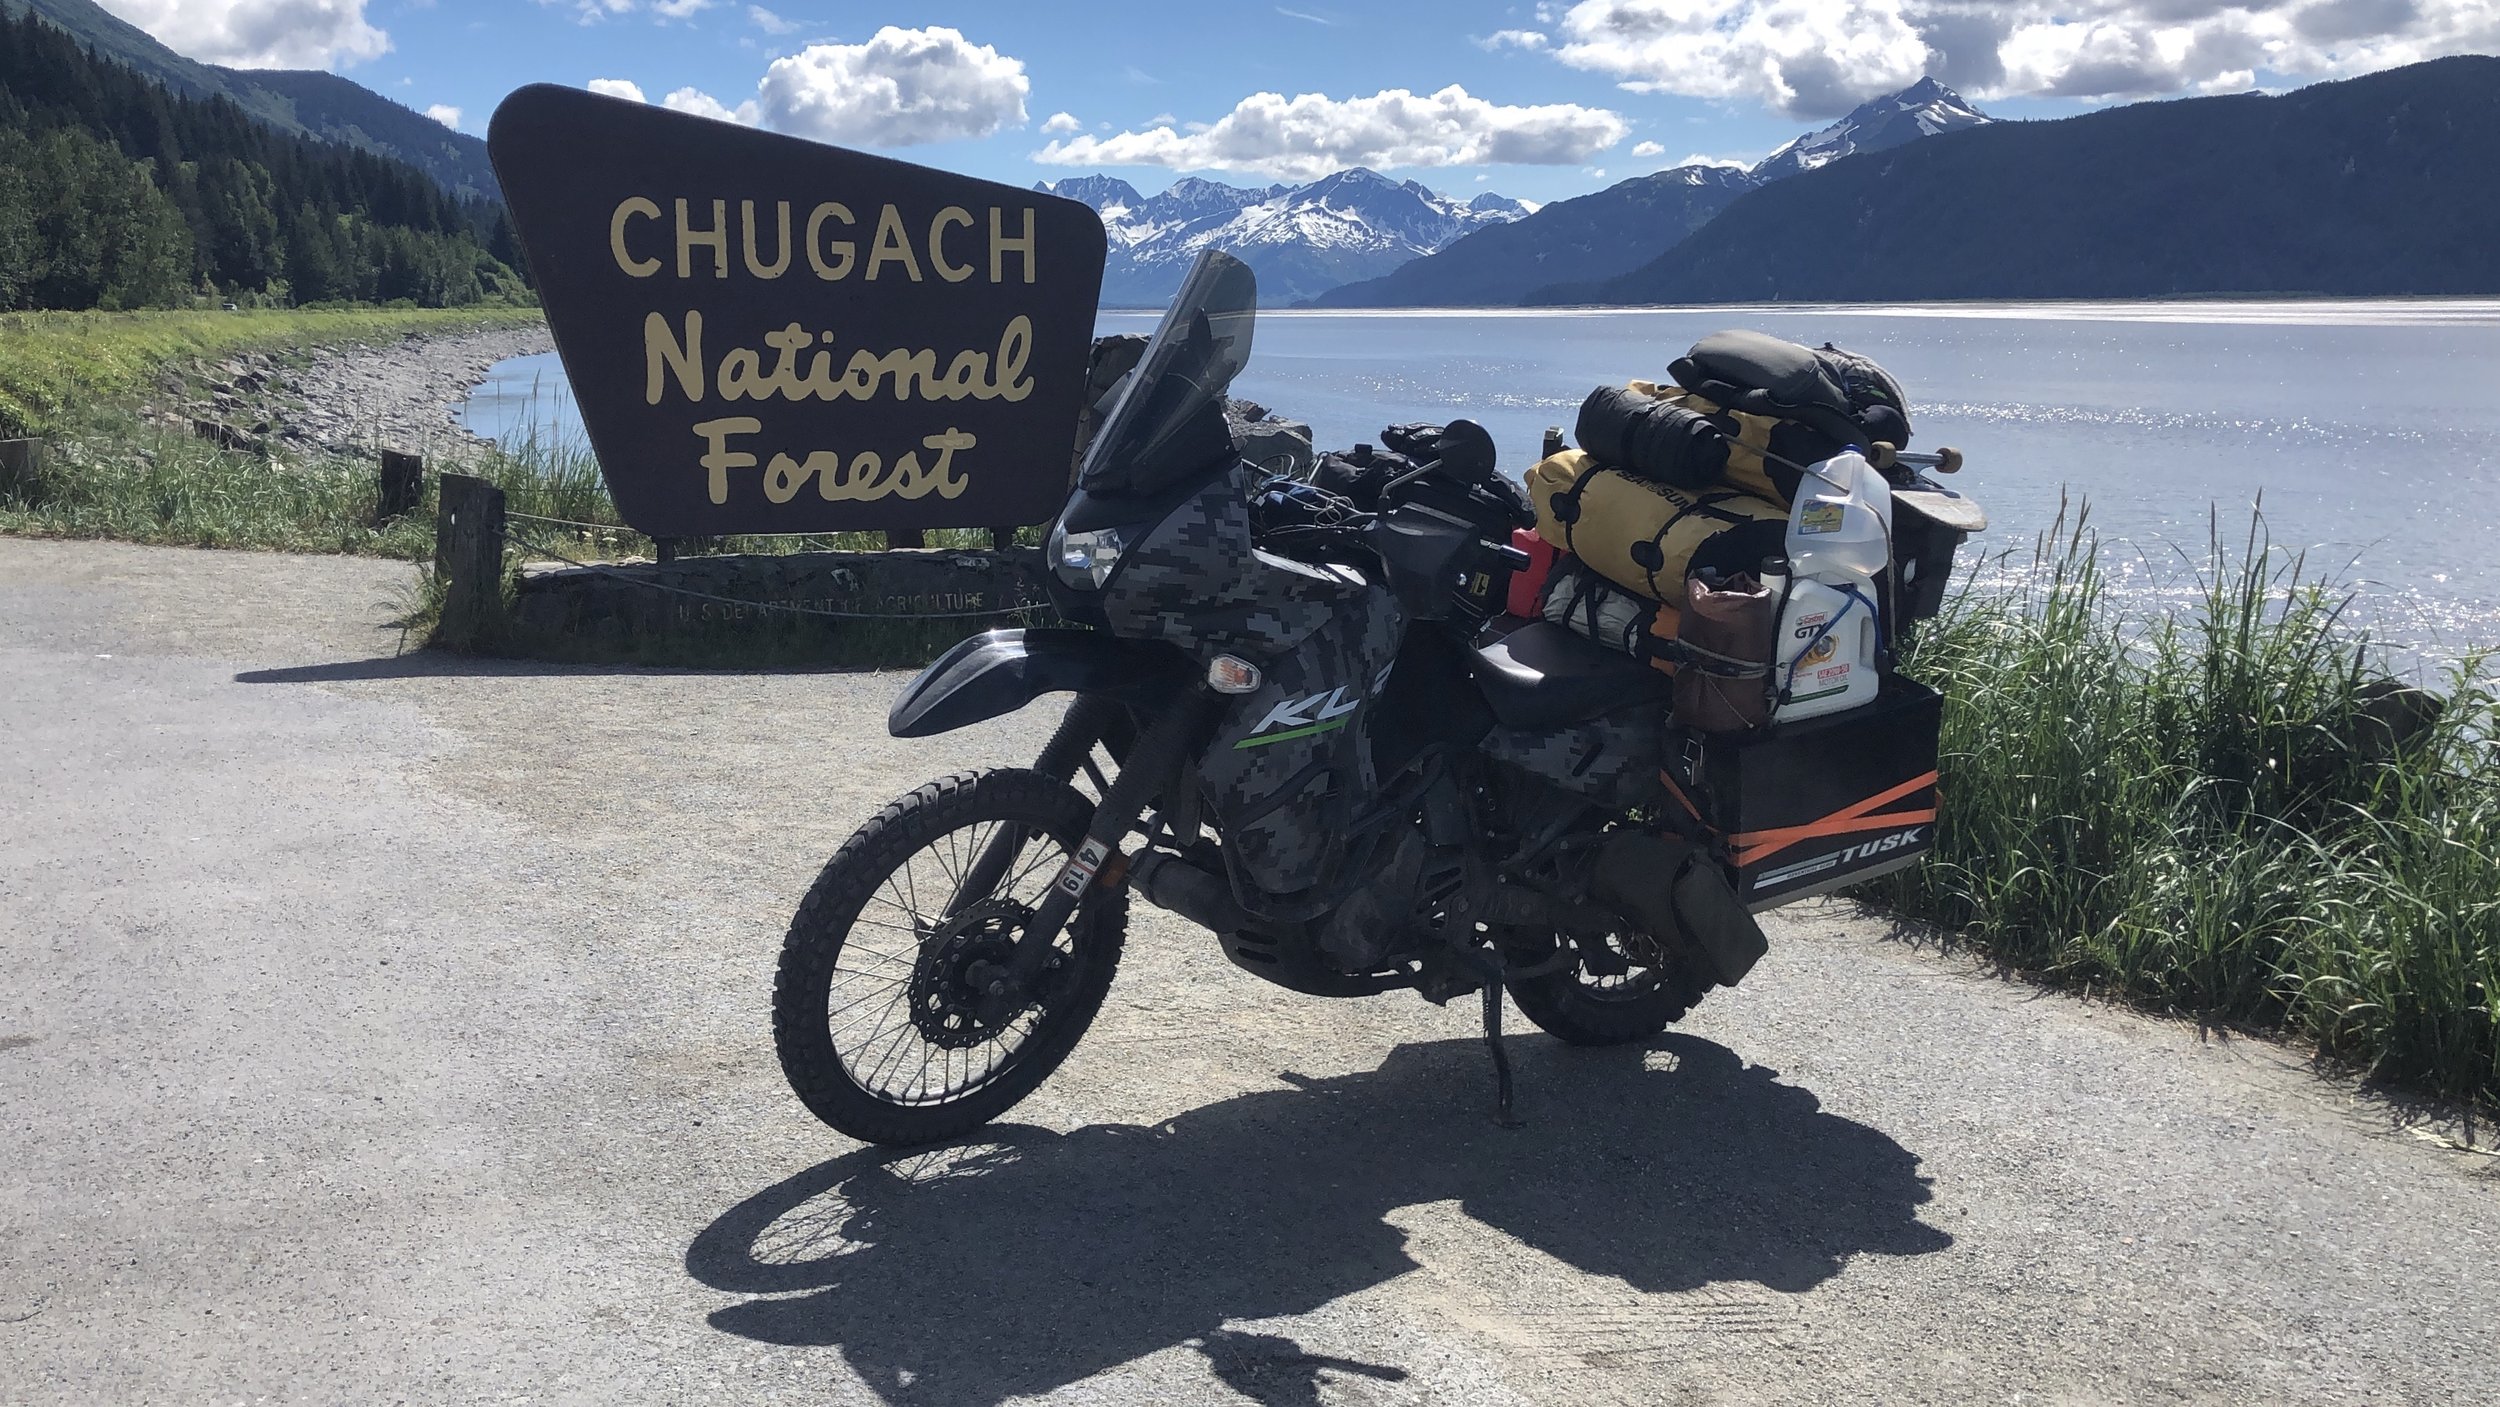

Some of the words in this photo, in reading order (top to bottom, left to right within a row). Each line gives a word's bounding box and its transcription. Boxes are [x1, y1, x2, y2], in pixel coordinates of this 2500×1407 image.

[610, 196, 1035, 284] CHUGACH
[644, 310, 1035, 405] National
[692, 417, 977, 505] Forest
[723, 598, 833, 621] DEARTMENT
[1079, 848, 1100, 867] 4
[1841, 826, 1926, 863] TUSK
[1062, 869, 1084, 891] 19
